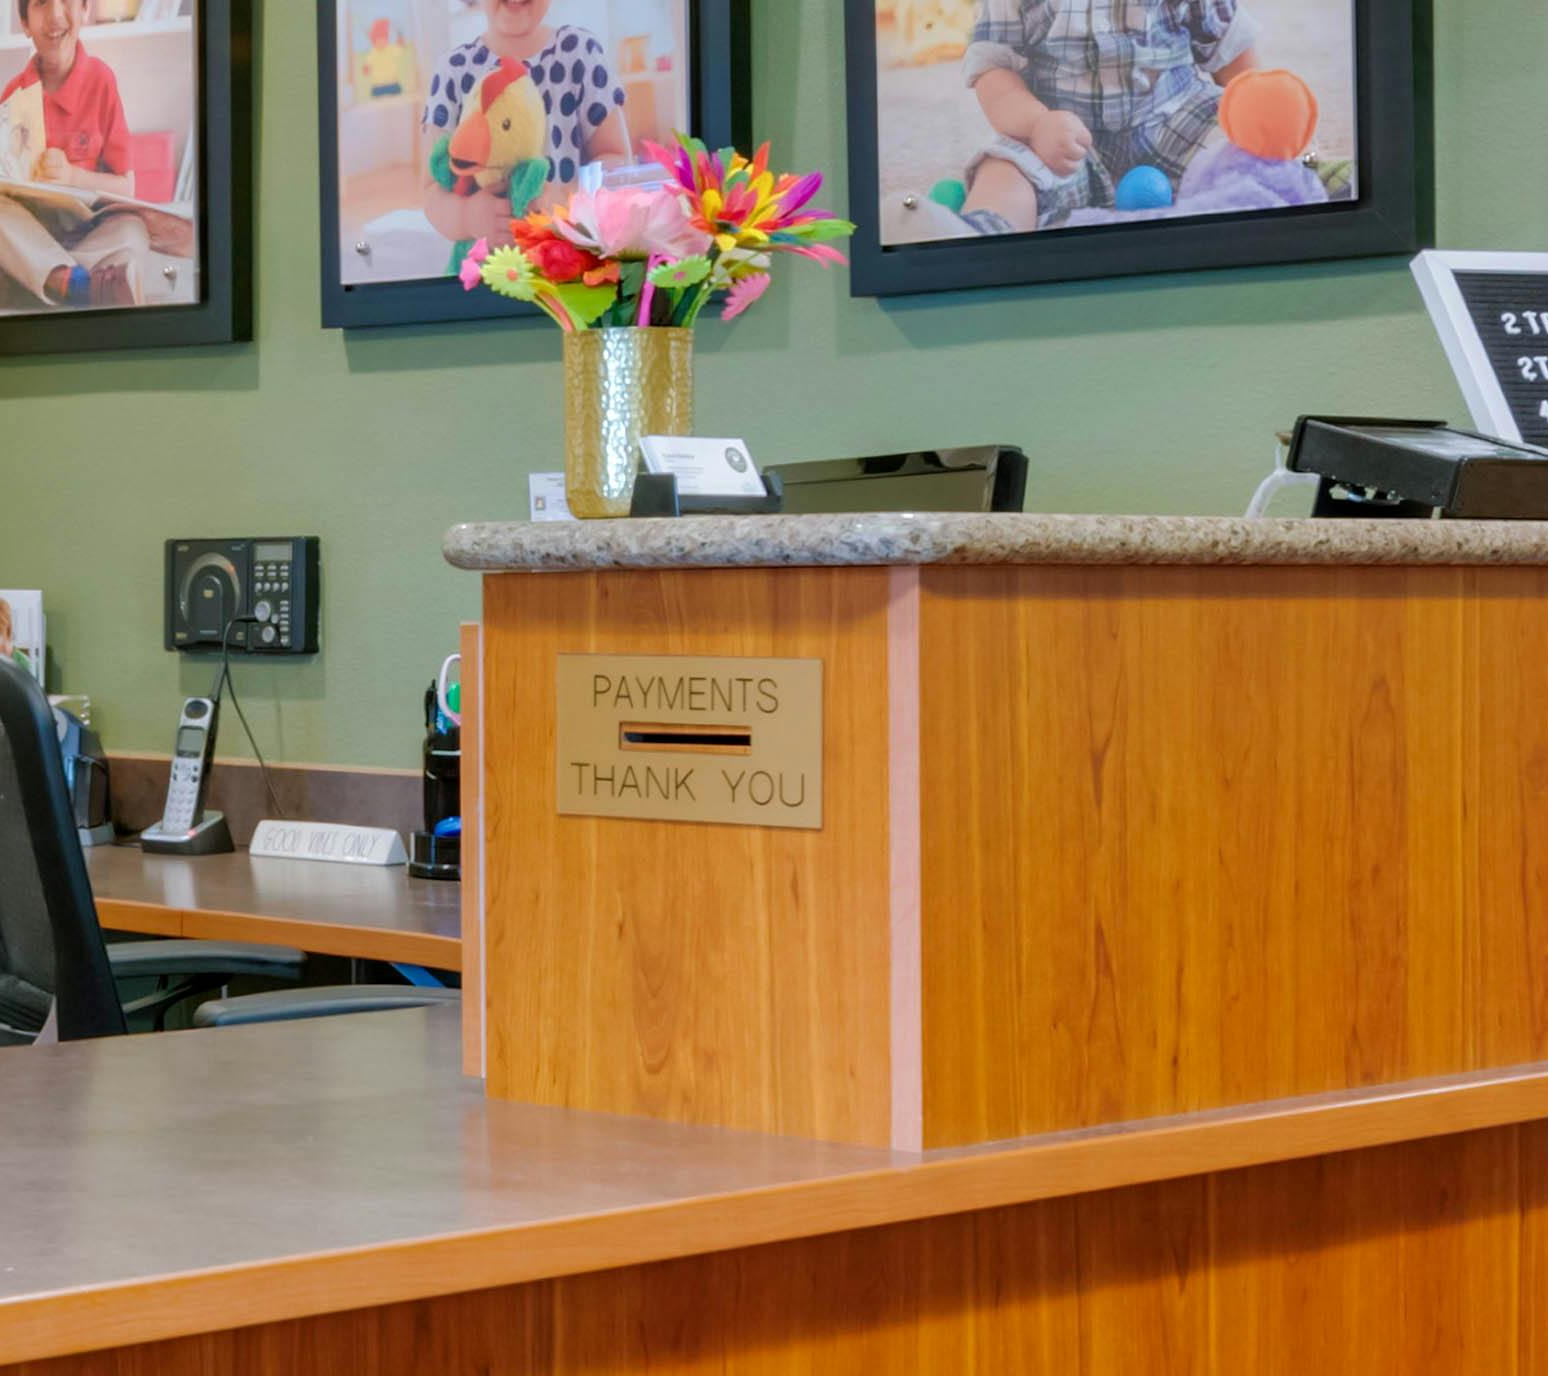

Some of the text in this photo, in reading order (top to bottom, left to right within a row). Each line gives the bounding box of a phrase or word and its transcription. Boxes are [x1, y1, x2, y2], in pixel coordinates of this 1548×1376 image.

[593, 674, 779, 714] PAYMENTS
[570, 761, 806, 808] THANK YOU
